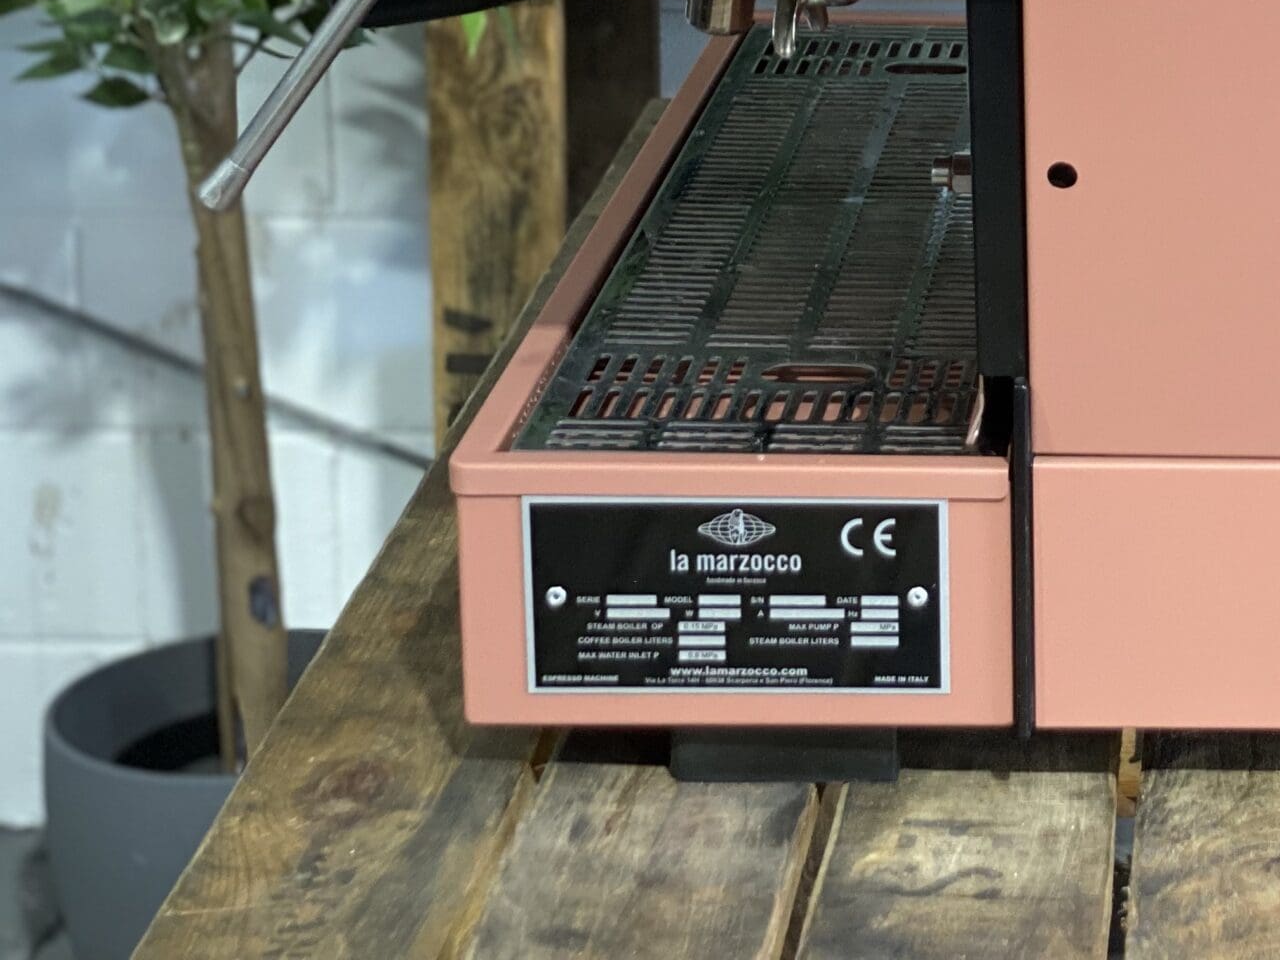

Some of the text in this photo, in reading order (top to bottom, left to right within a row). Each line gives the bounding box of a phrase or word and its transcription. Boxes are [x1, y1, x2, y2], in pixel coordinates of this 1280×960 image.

[670, 549, 802, 572] la marzocco
[576, 596, 601, 604] SERIE
[664, 596, 693, 604] MODEL
[836, 596, 858, 605] DATE
[788, 623, 840, 631] MAX PUMP P
[879, 623, 896, 631] MPa
[749, 637, 839, 645] STEAM BOILER LITERS
[578, 651, 660, 659] MAX WATER INLET P
[670, 665, 808, 675] www.lamarzocco.com
